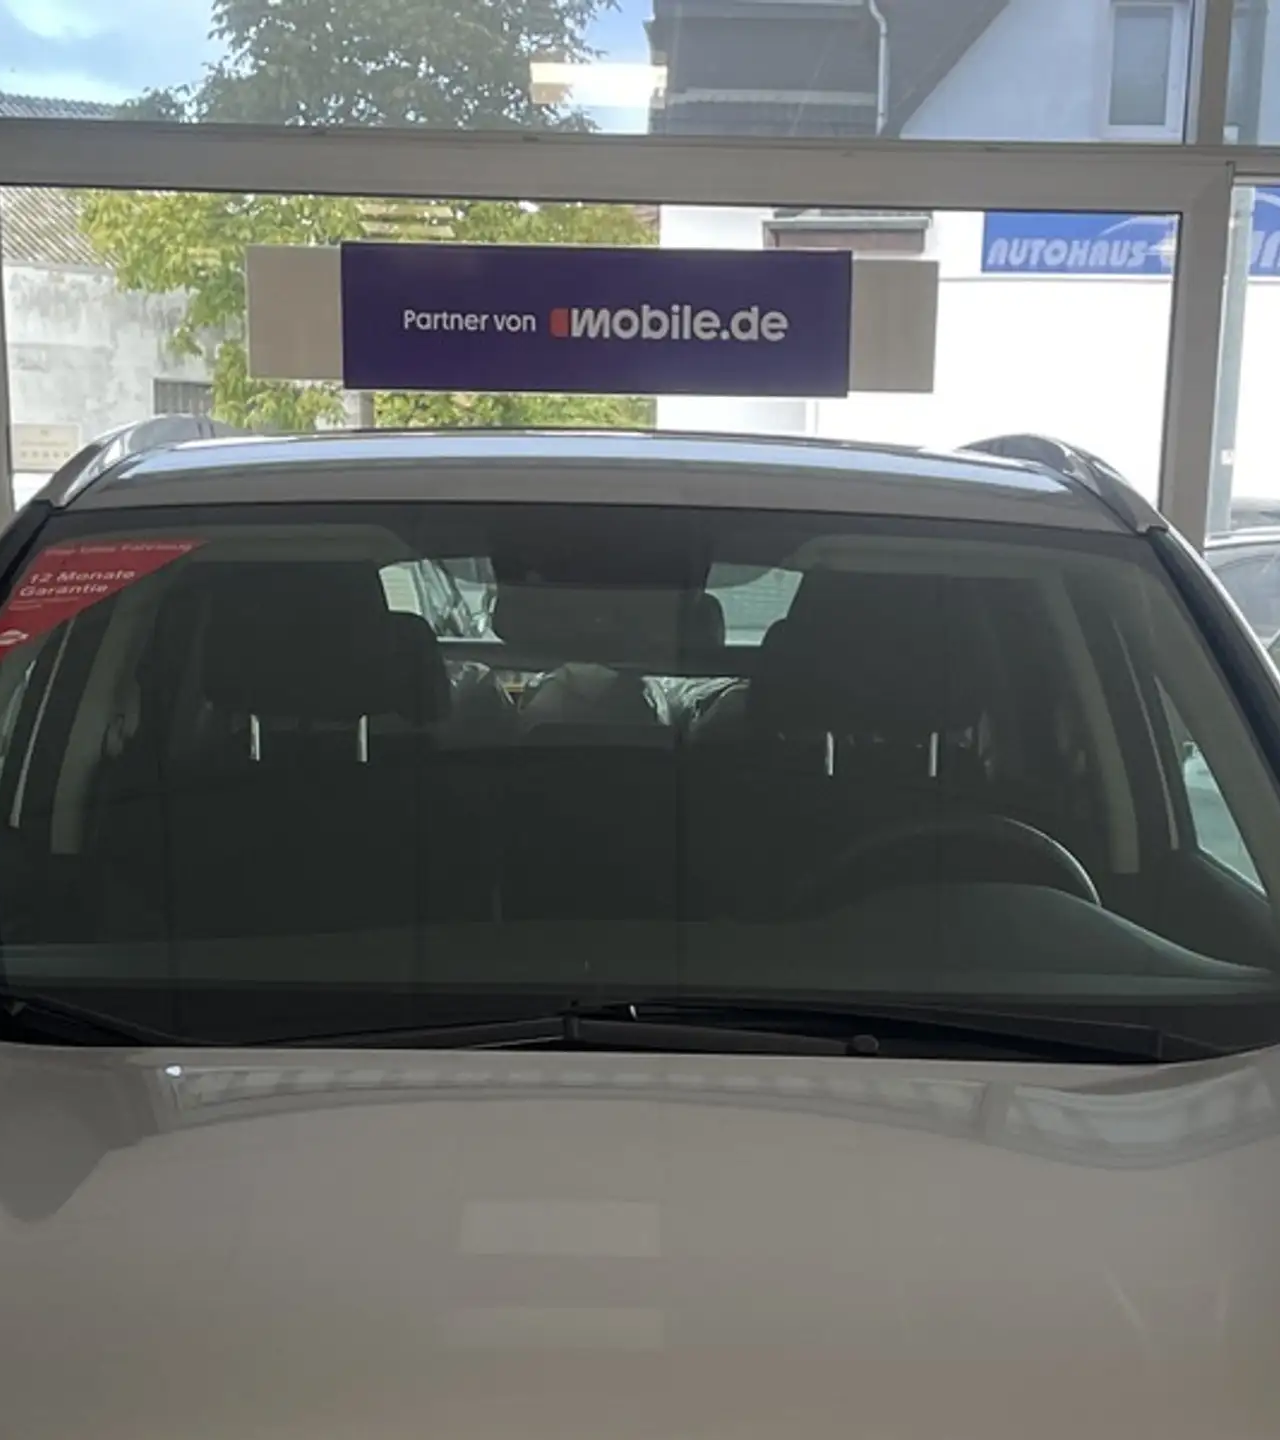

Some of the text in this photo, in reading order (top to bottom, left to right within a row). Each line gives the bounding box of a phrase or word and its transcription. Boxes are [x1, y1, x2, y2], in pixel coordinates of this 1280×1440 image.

[986, 237, 1150, 268] AUTOHAUS
[402, 303, 790, 342] Partner von mobile.de
[30, 569, 136, 585] 12 Monate
[20, 583, 109, 597] Garantie
